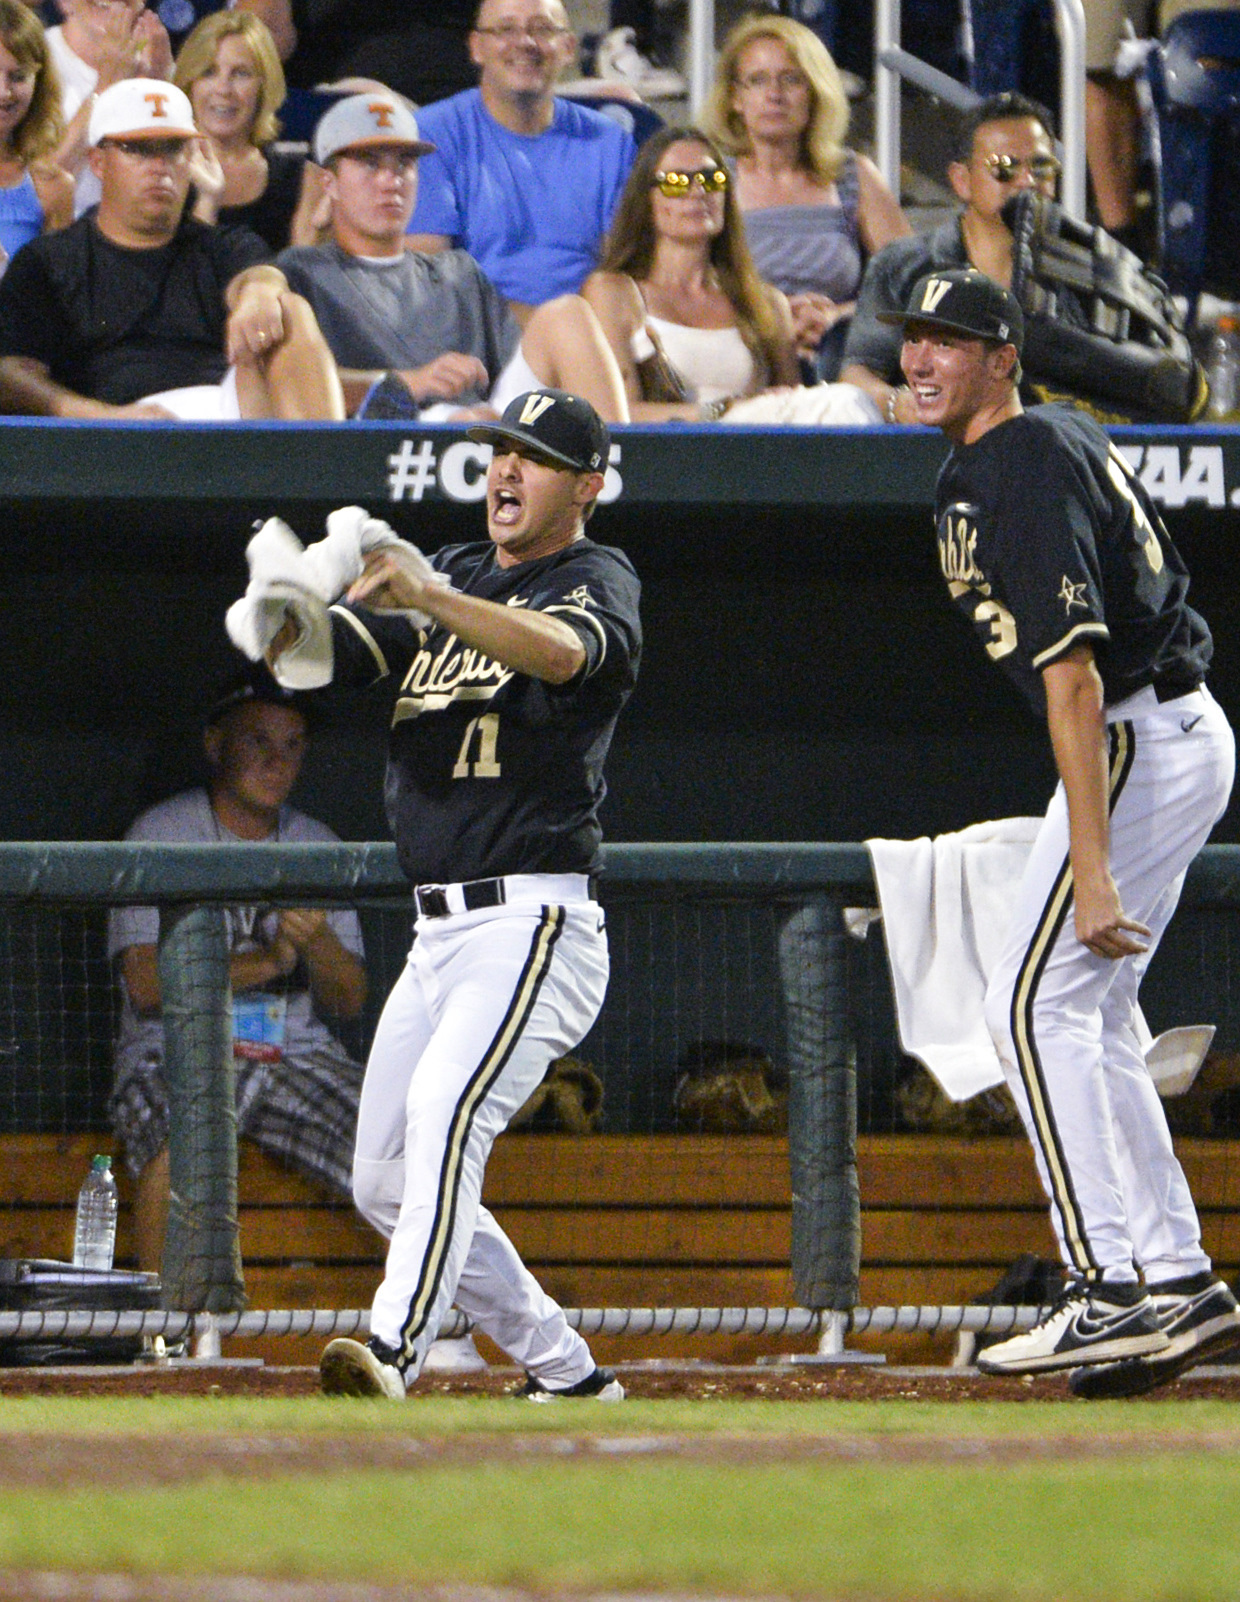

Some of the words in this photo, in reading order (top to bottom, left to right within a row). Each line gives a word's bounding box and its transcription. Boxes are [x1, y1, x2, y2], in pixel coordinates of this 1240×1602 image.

[144, 93, 169, 118] T
[368, 102, 394, 127] T
[920, 278, 953, 313] V
[518, 394, 556, 426] V
[452, 712, 501, 779] 11
